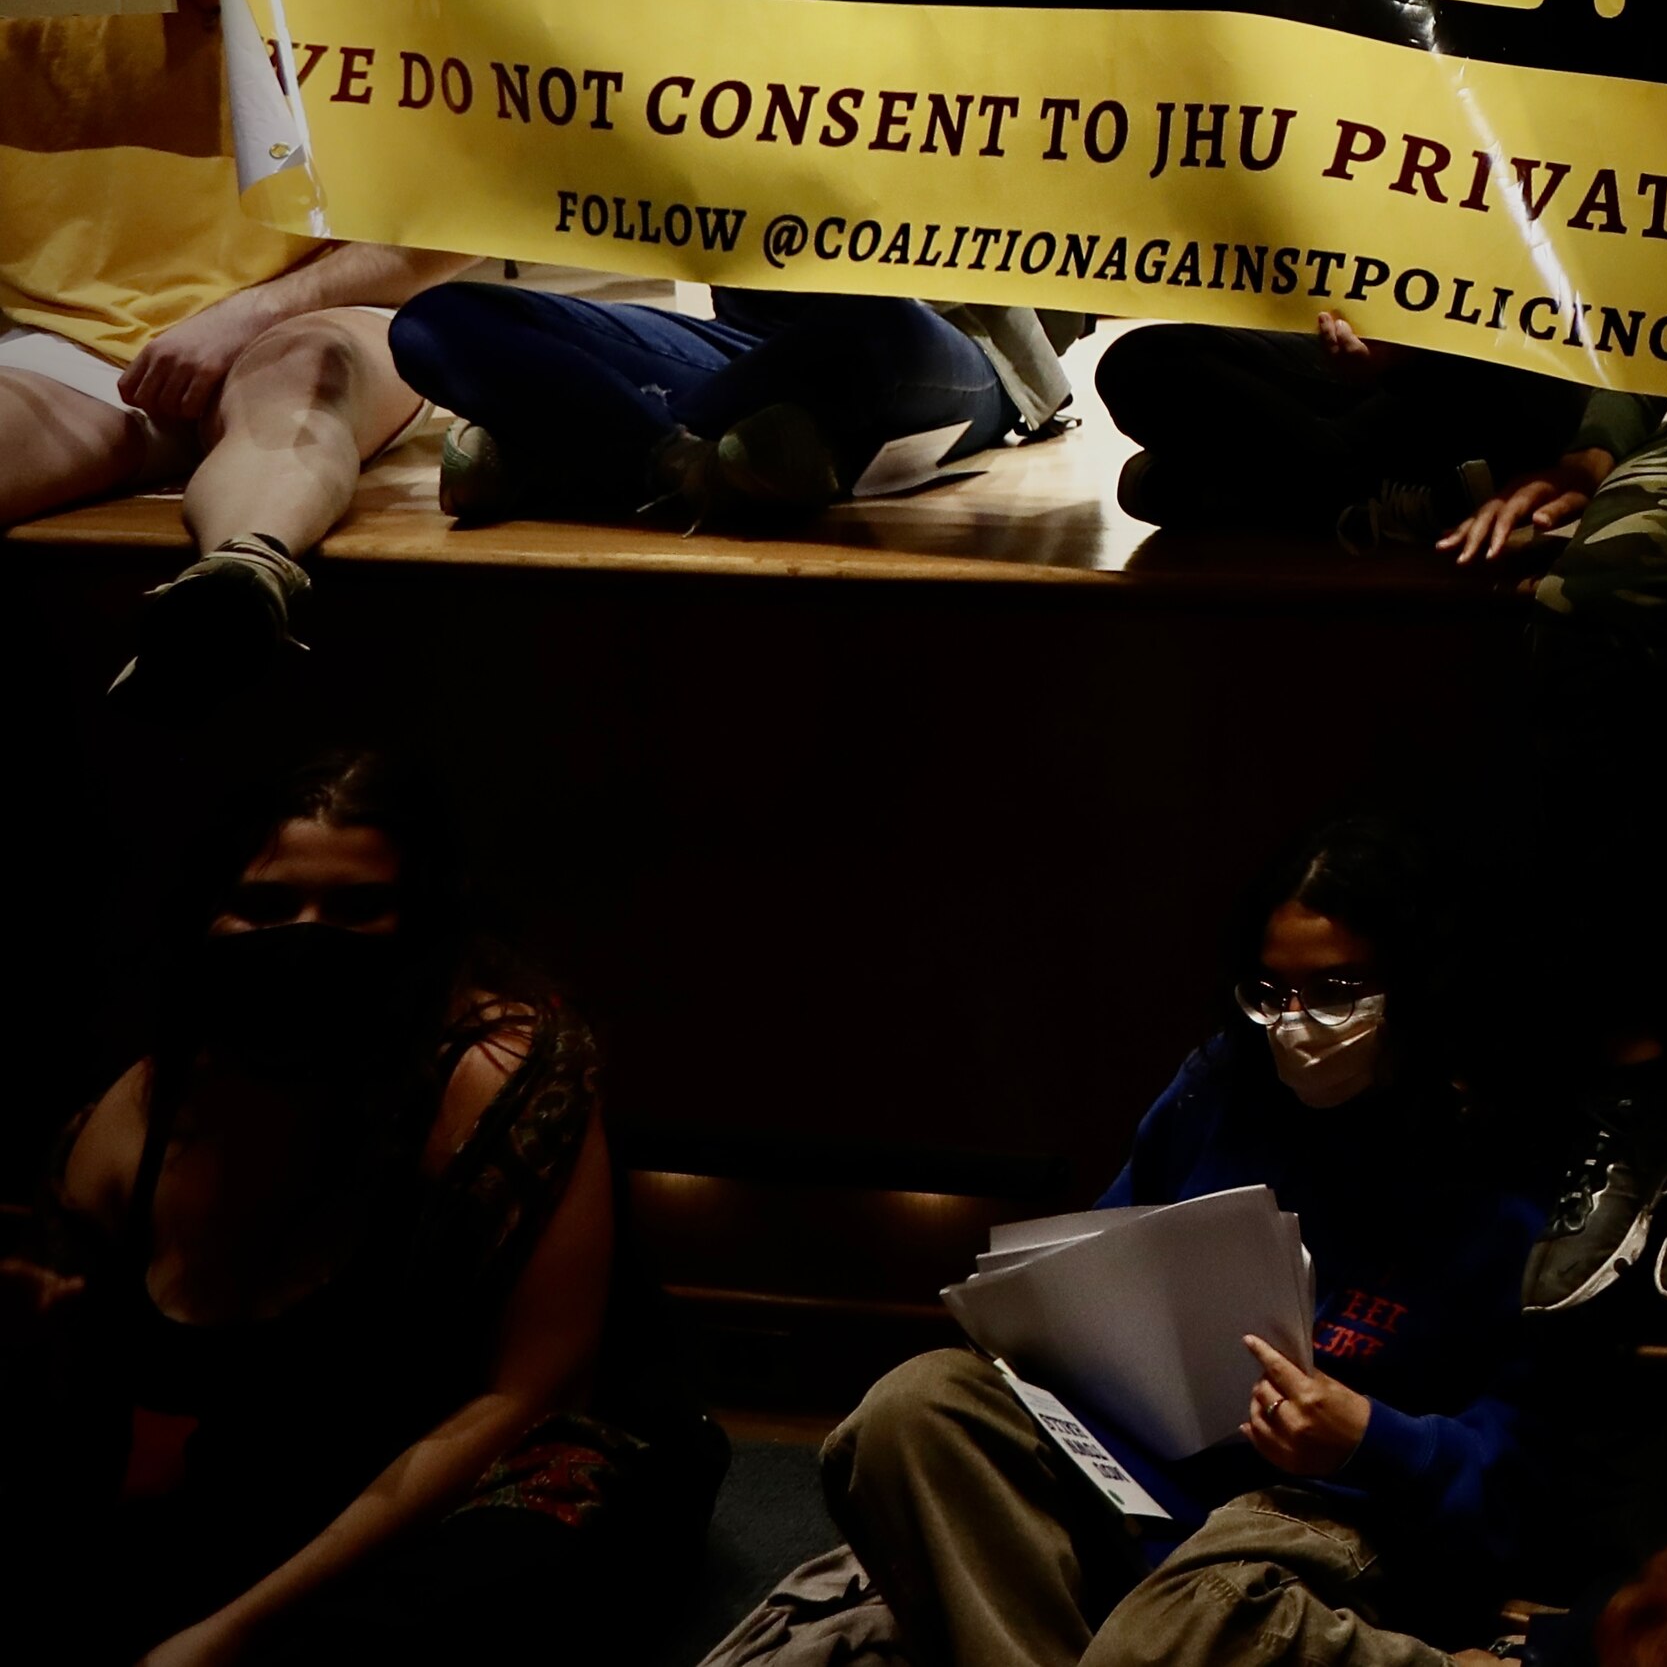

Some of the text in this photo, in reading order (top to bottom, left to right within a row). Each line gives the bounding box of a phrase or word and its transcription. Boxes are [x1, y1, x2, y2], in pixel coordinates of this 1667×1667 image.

[398, 51, 473, 115] DO
[489, 61, 623, 131] NOT
[646, 74, 1019, 158] CONSENT
[1040, 98, 1128, 164] TO
[1150, 102, 1297, 179] JHU
[555, 189, 749, 253] FOLLOW
